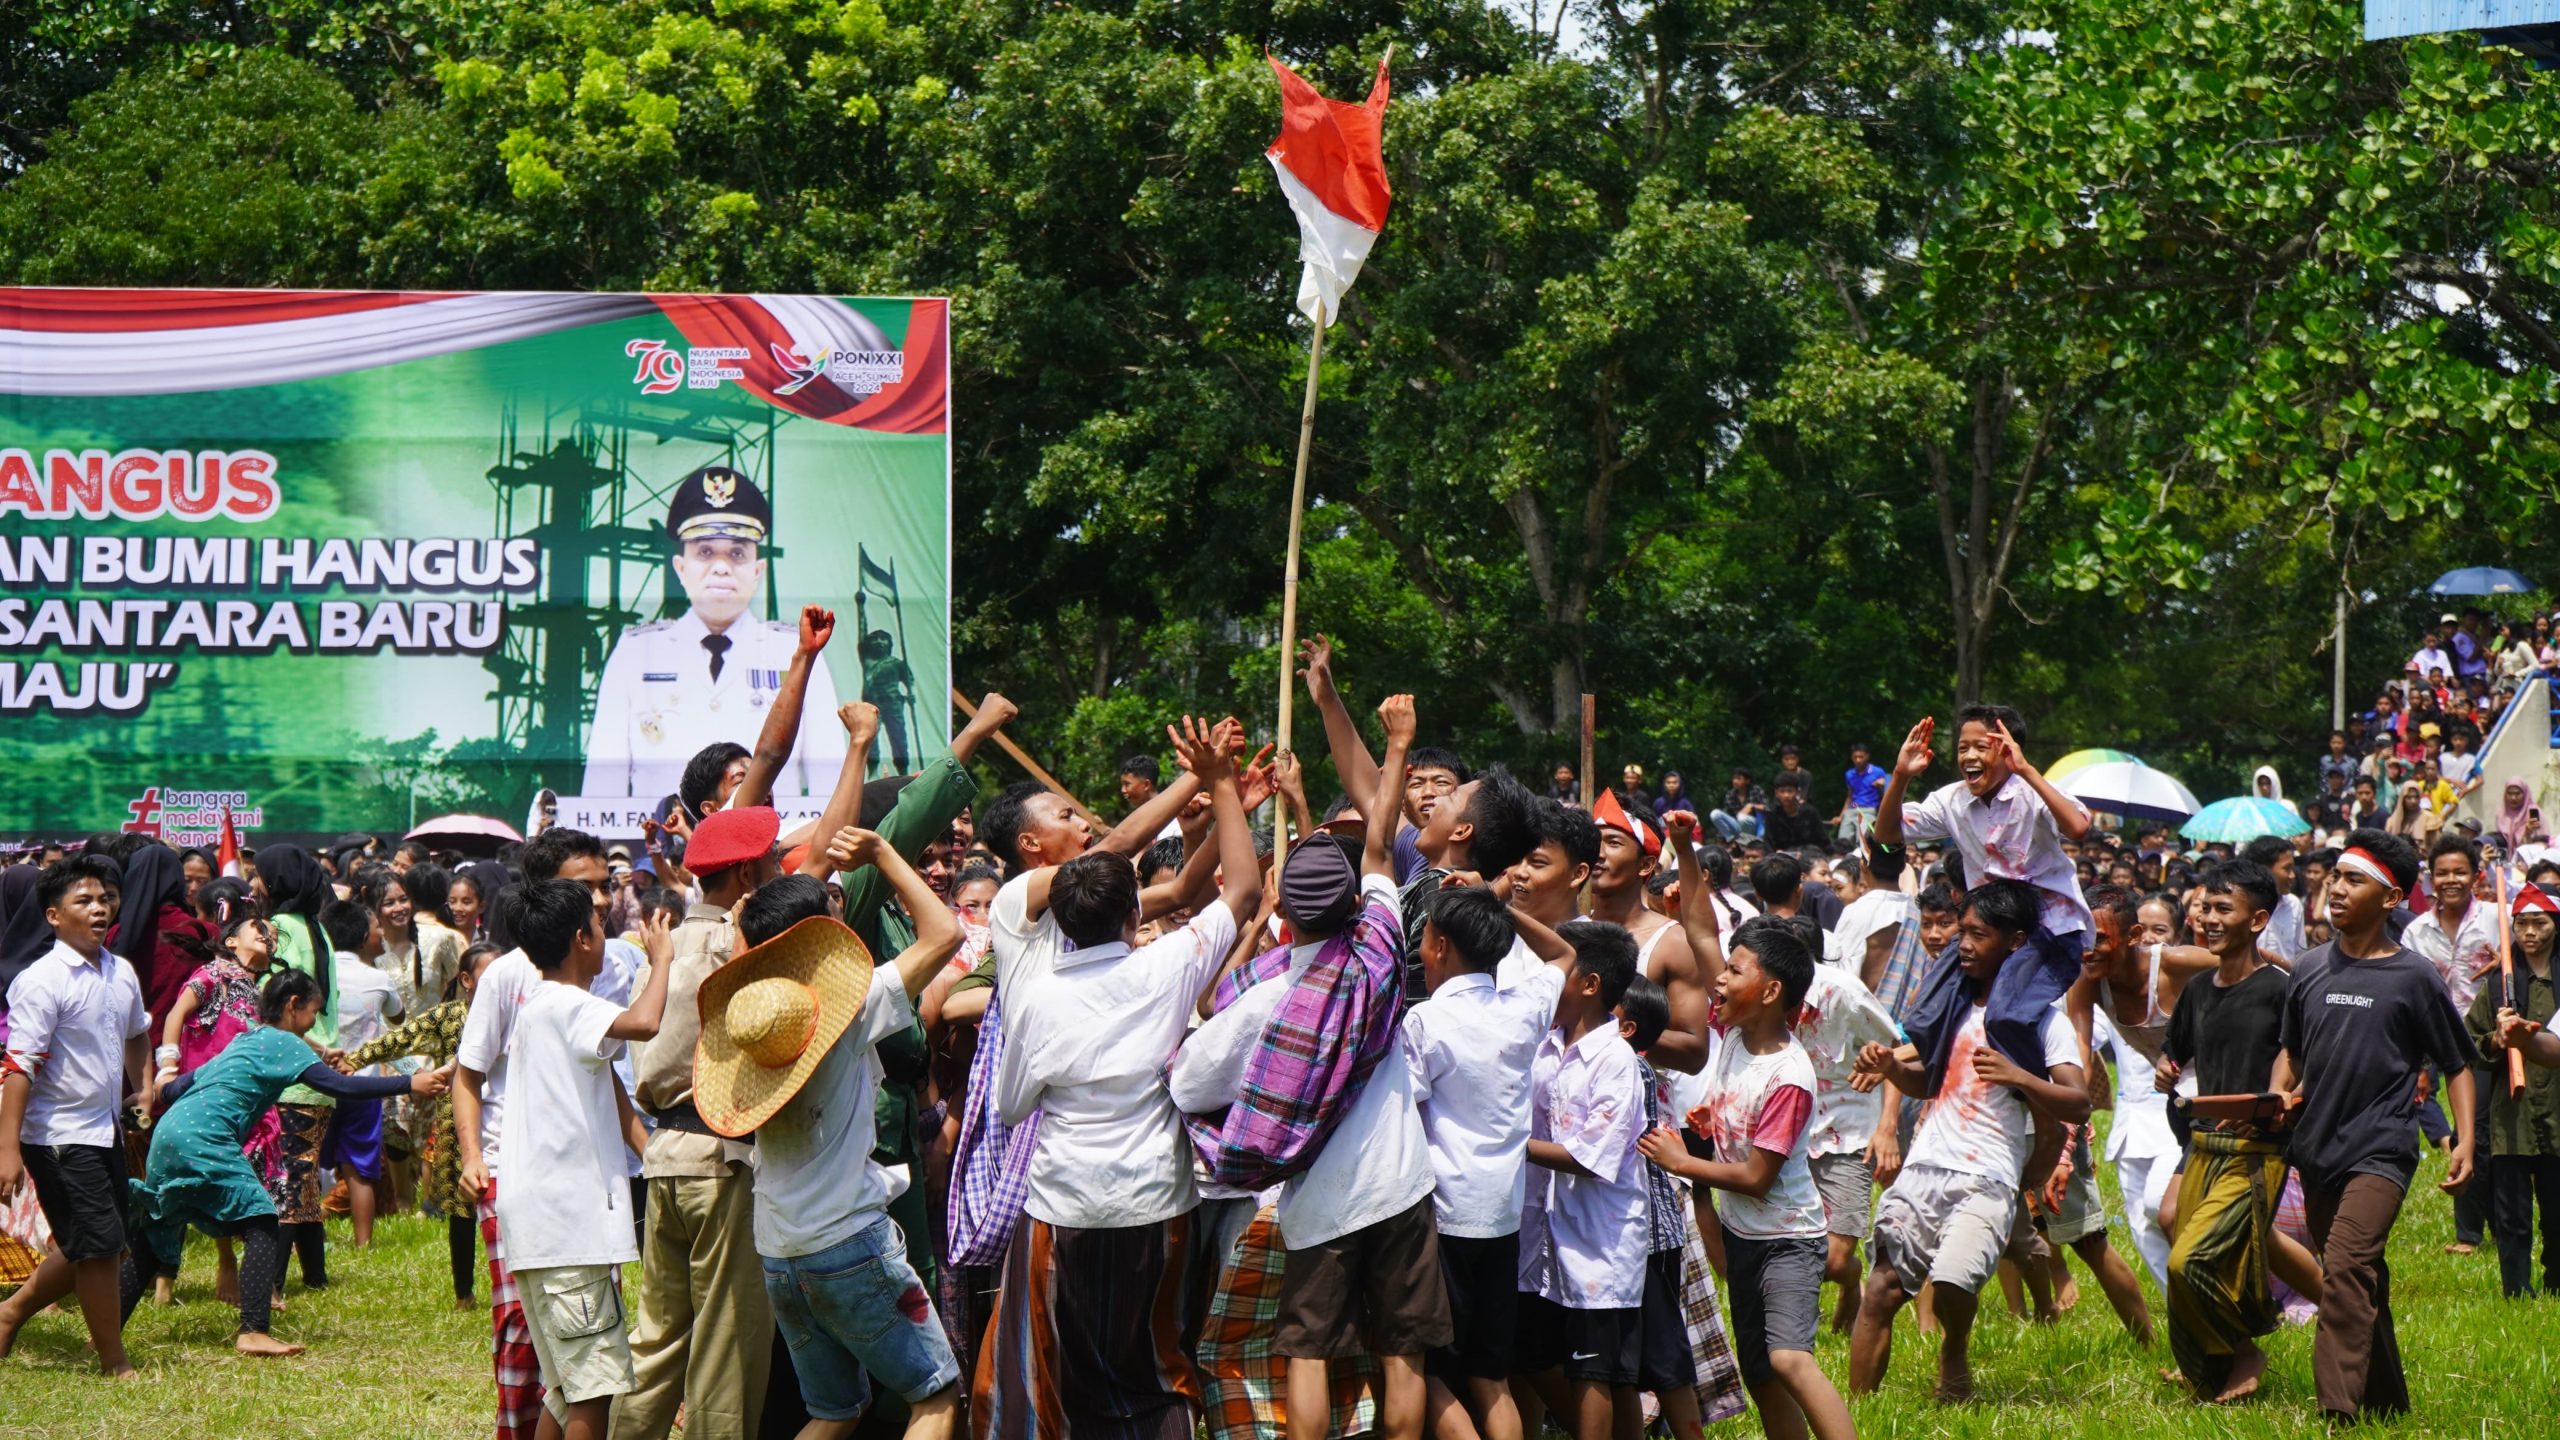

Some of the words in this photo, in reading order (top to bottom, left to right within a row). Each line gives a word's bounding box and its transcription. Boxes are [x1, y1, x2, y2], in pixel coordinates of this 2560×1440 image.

[690, 350, 749, 358] NUSANTARA
[834, 351, 870, 364] PON
[875, 353, 902, 365] XXI
[690, 359, 716, 367] BARU
[690, 370, 742, 378] INDONESIA
[690, 379, 718, 387] MAJU
[855, 384, 880, 392] 2024
[82, 536, 248, 584] BUMI
[261, 538, 536, 586] HANGUS
[319, 601, 501, 648] BARU
[165, 789, 246, 811] bangga
[2325, 993, 2374, 1009] GREENLIGHT
